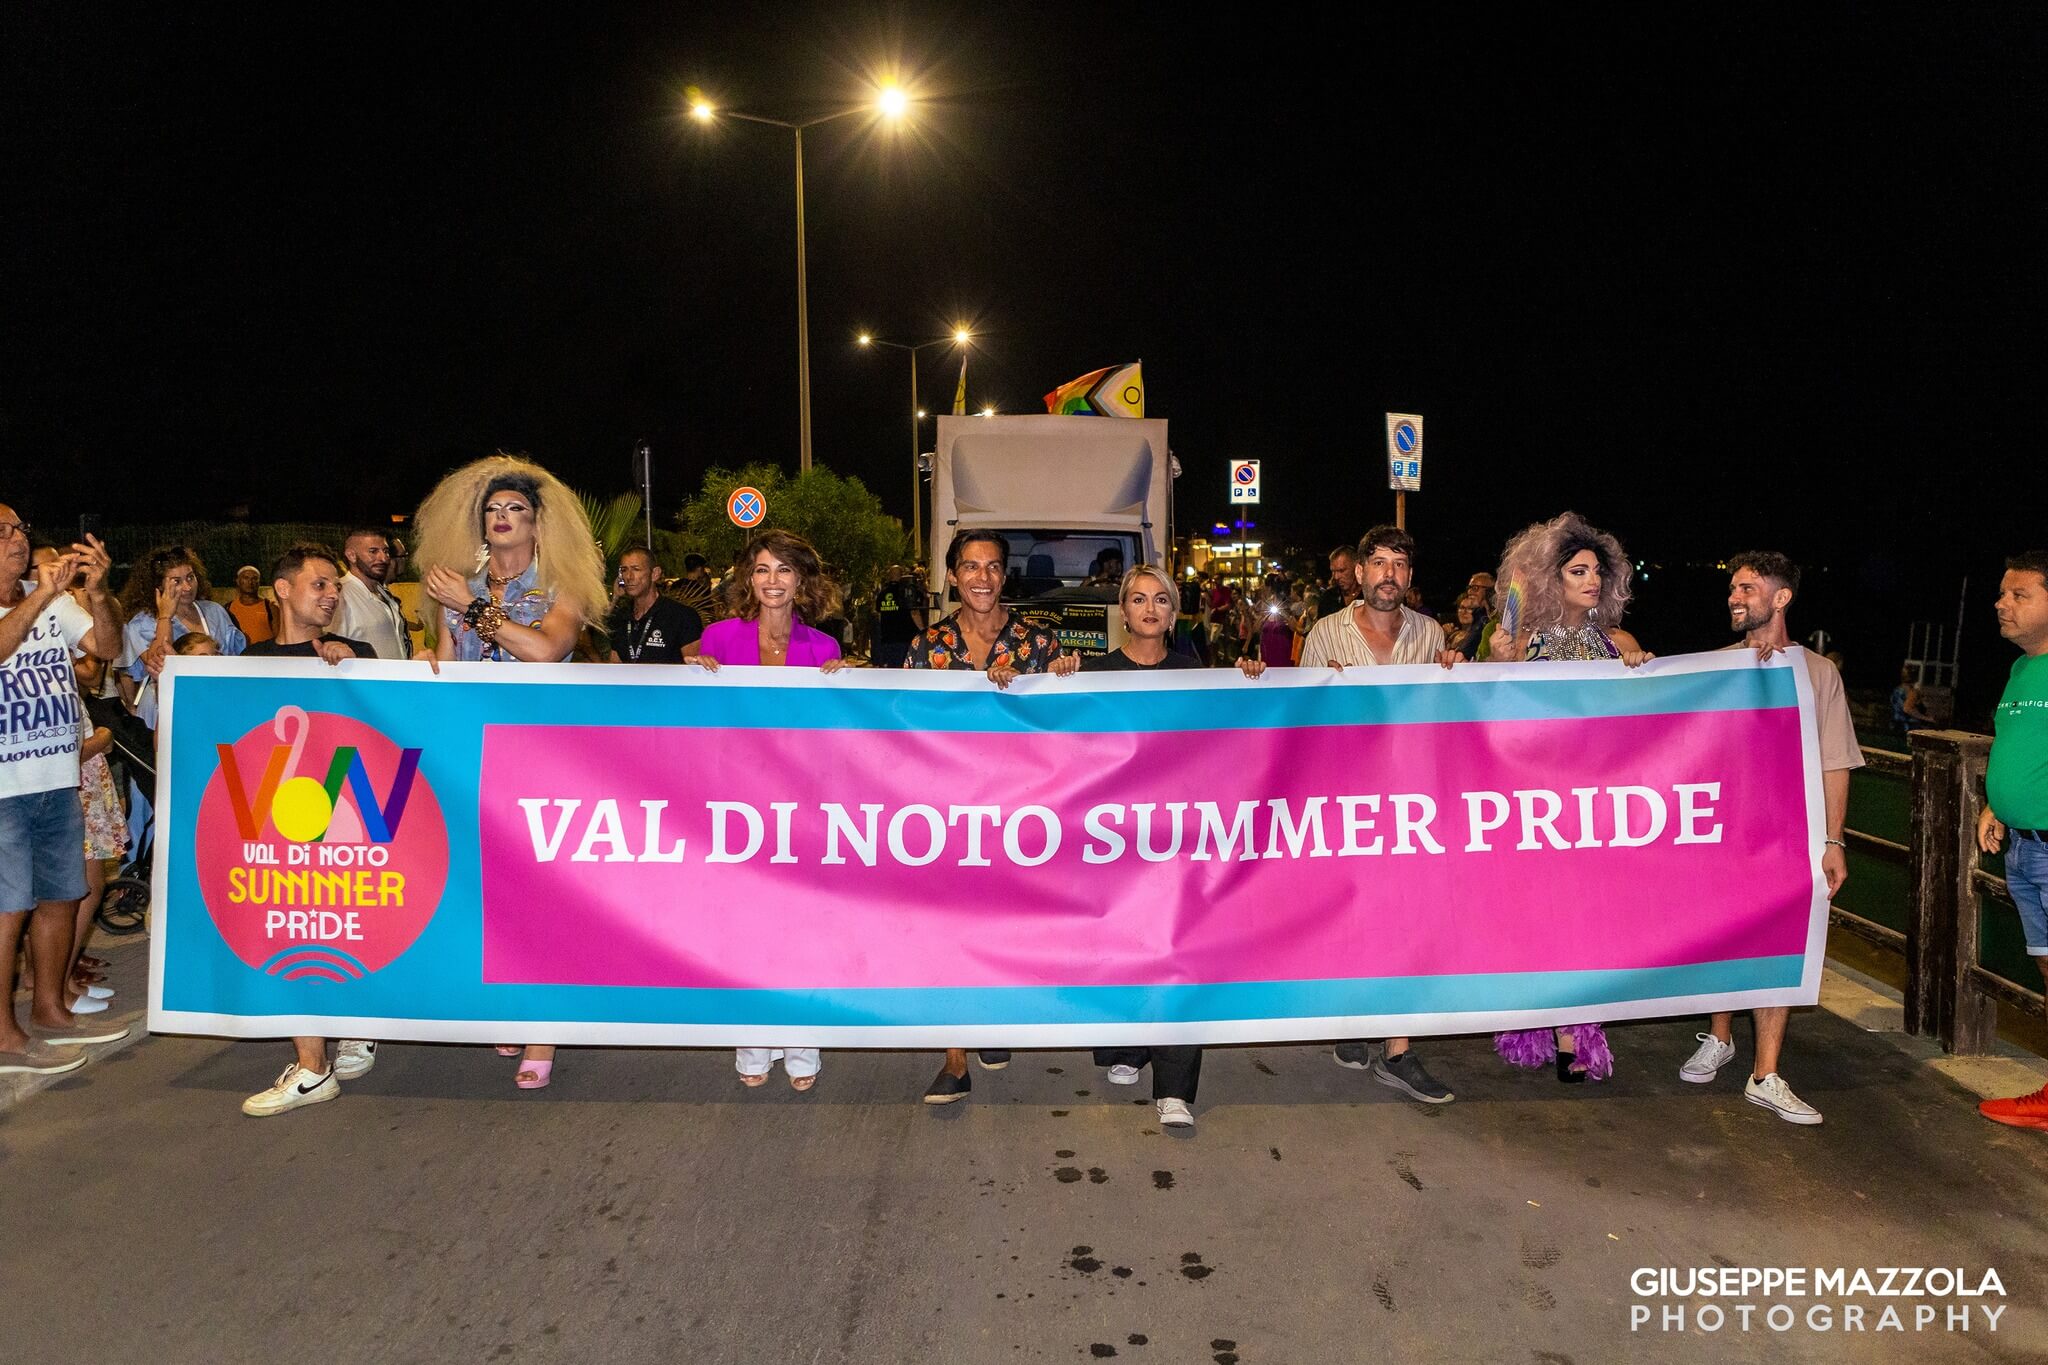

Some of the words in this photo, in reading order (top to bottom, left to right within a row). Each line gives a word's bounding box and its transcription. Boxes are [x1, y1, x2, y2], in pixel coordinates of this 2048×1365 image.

[1070, 631, 1105, 640] USATE
[27, 726, 68, 742] BACIO
[518, 797, 686, 863] VAL
[705, 800, 799, 864] DI
[821, 802, 1063, 867] NOTO
[1082, 793, 1446, 864] SUMMER
[1461, 781, 1725, 853] PRIDE
[319, 845, 389, 866] NOTO
[227, 866, 406, 907] SUMMER
